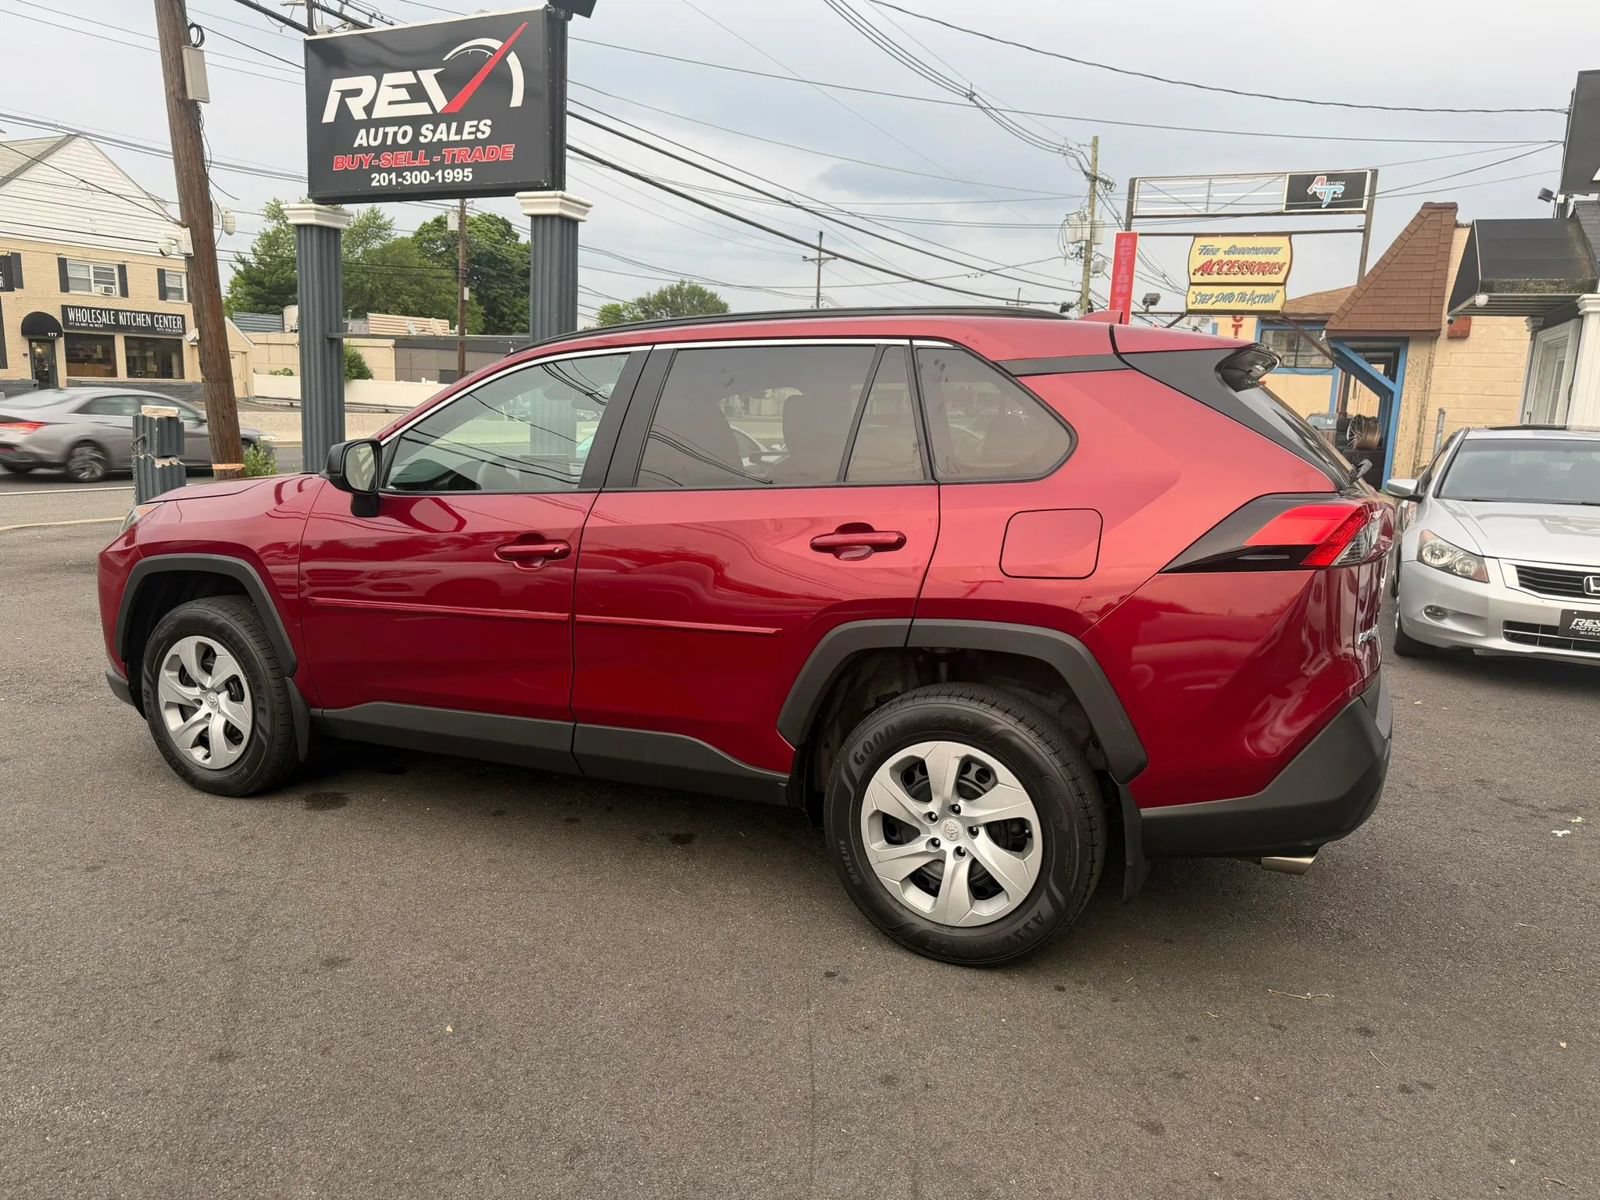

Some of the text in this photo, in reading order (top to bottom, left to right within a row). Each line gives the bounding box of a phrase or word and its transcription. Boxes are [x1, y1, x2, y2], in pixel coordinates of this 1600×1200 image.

[353, 119, 492, 148] AUTO SALES
[370, 168, 473, 187] 201-300-1995
[1192, 258, 1287, 276] ACCESSORIES
[67, 307, 183, 330] WHOLESALE KITCHEN CENTER
